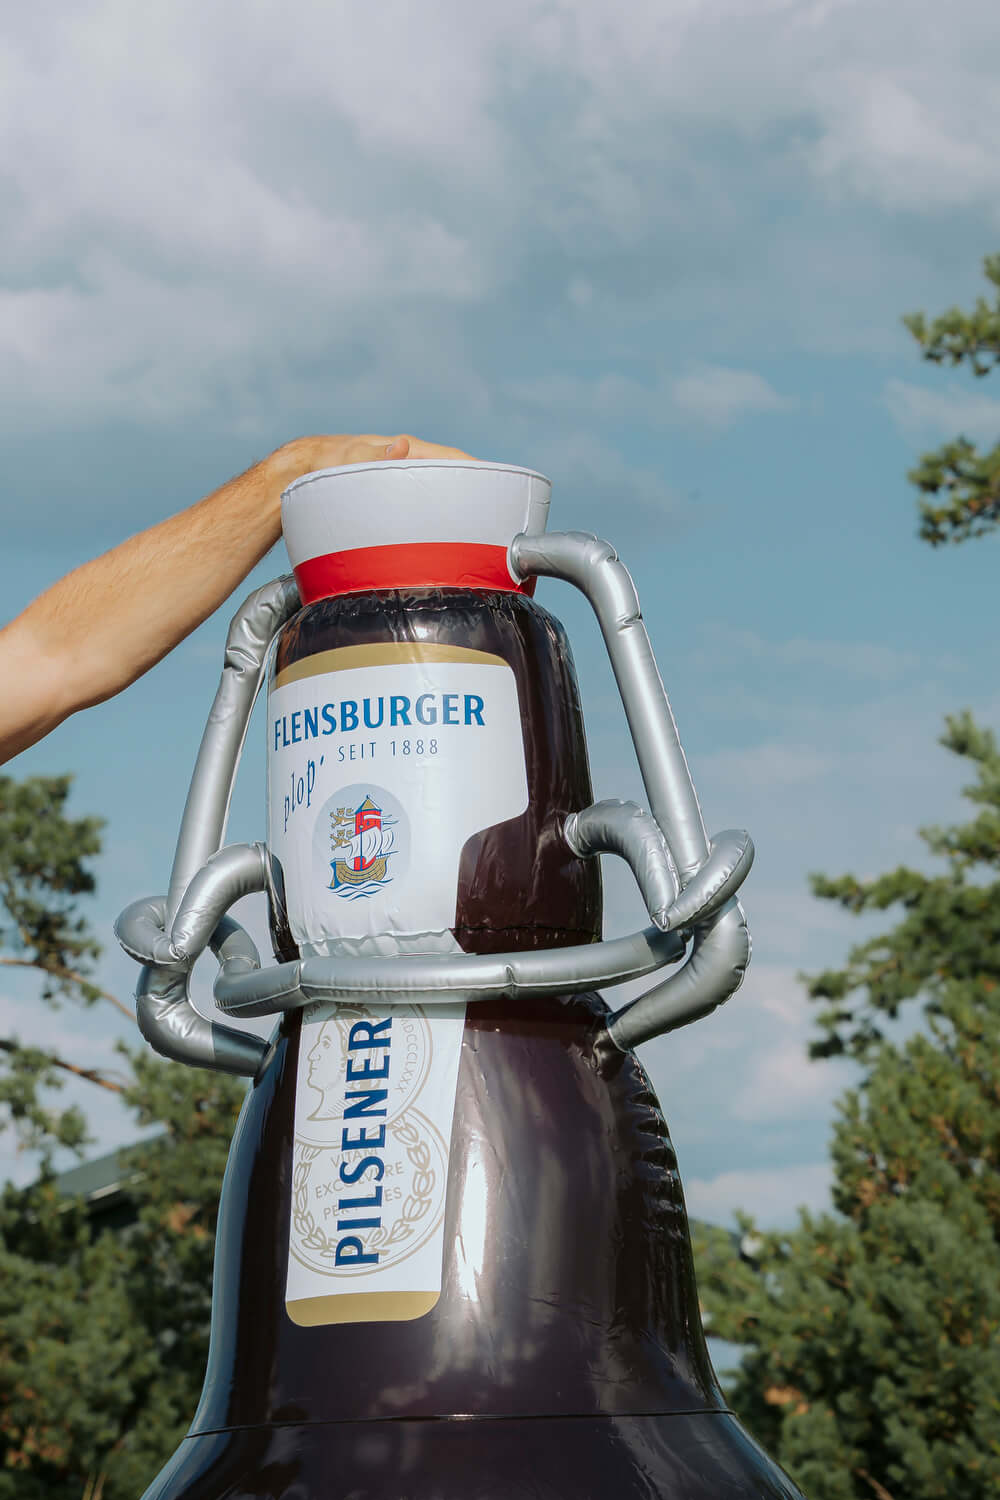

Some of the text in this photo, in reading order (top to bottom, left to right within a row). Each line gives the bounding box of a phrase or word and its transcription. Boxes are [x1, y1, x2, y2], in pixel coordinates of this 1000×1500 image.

[273, 693, 487, 752] FLENSBURGER
[337, 739, 439, 763] SEIT 1888
[334, 1016, 393, 1268] PILSENER
